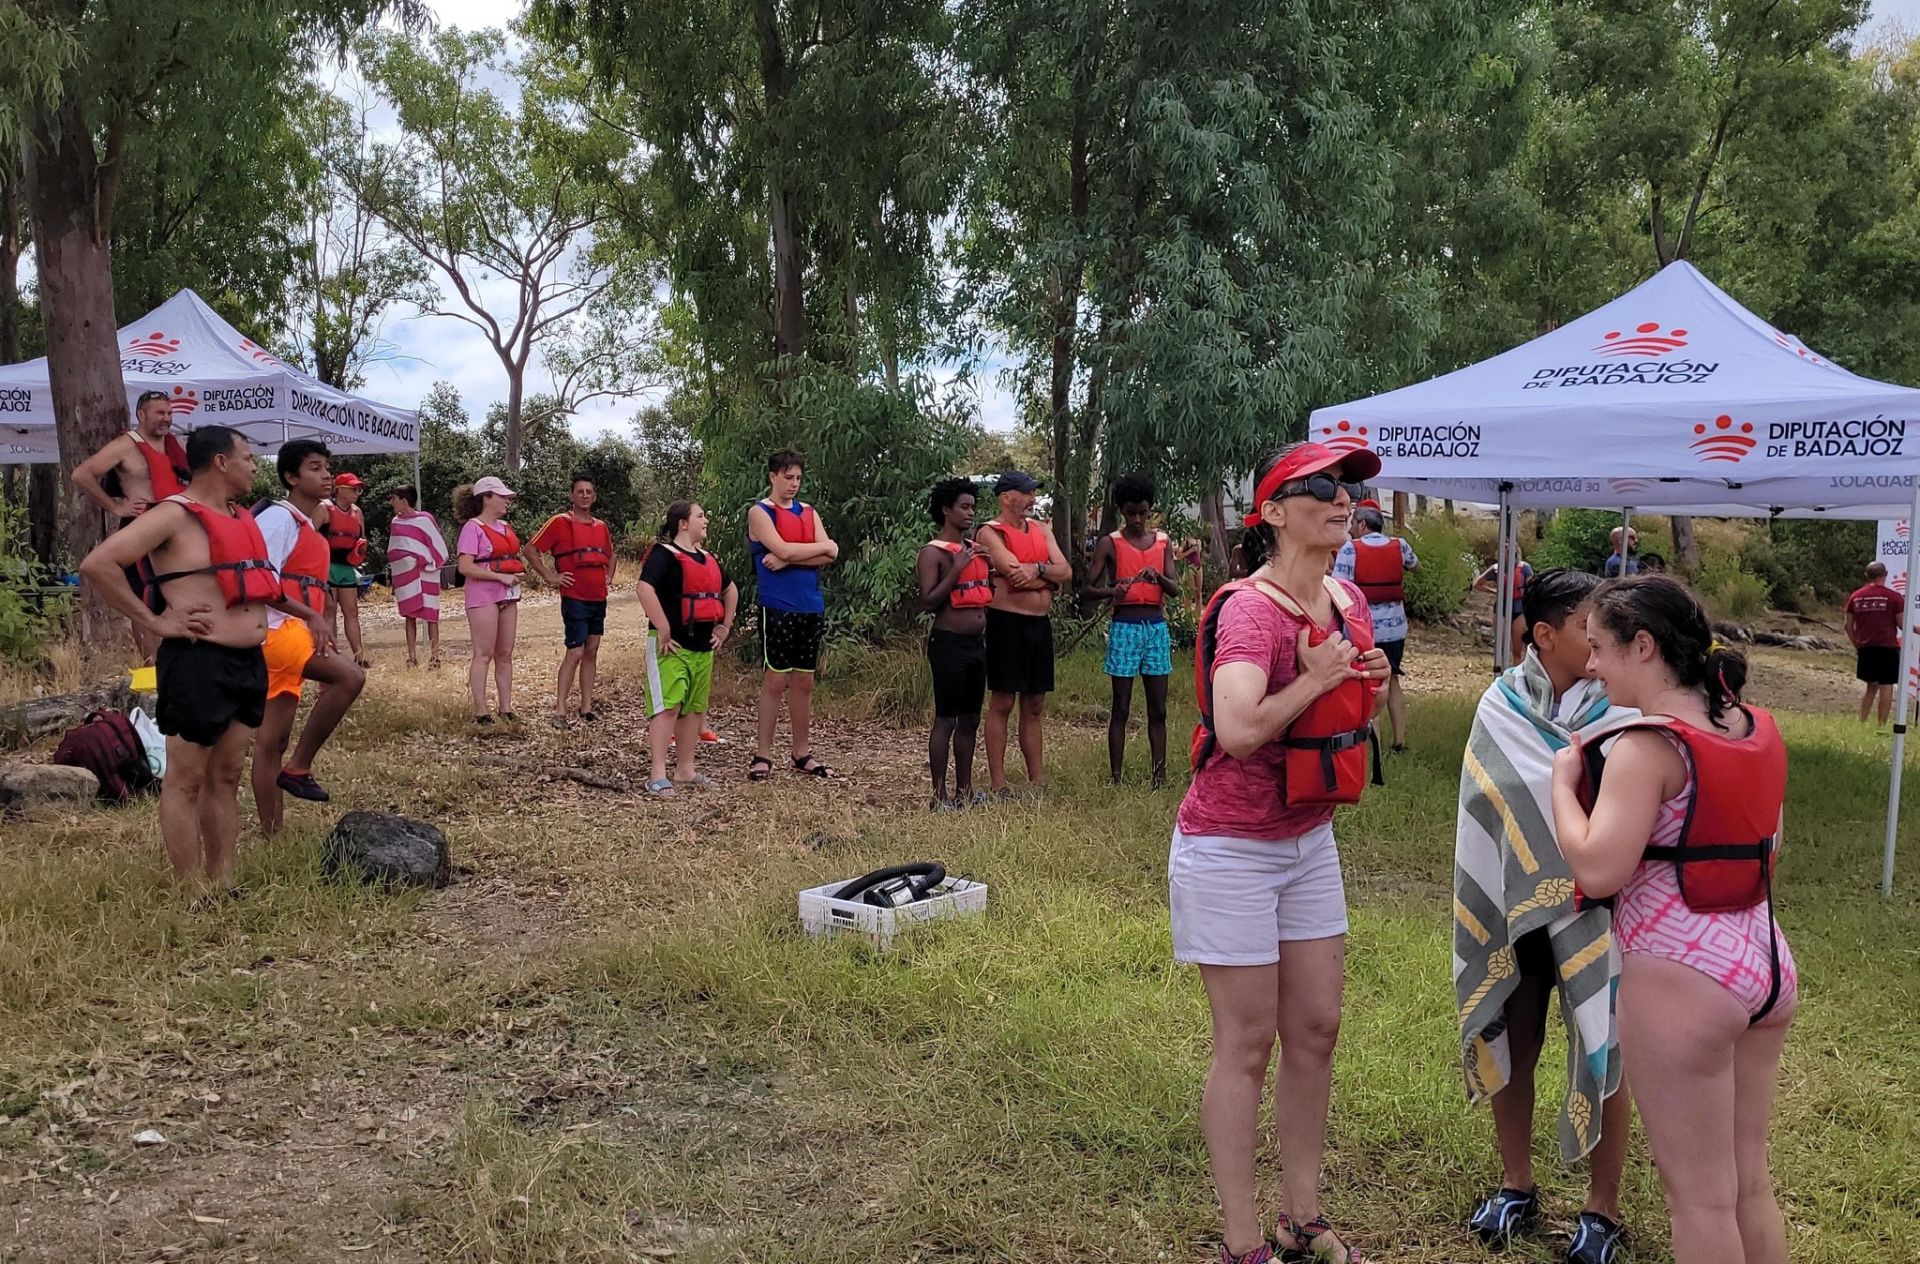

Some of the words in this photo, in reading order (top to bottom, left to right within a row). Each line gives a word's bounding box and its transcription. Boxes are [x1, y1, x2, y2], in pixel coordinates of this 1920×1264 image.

[1532, 359, 1719, 379] DIPUTACIÓN
[1521, 380, 1553, 390] DE
[1559, 373, 1712, 387] BADAJOZ
[203, 384, 275, 401] DIPUTACIÓN
[204, 403, 216, 412] DE
[219, 398, 275, 412] BADAJOZ
[291, 389, 355, 428] DIPUTACIÓN
[358, 411, 369, 432] DE
[371, 415, 414, 442] BADAJOZ
[1379, 421, 1481, 442] DIPUTACIÓN
[1769, 414, 1906, 440] DIPUTACIÓN
[1376, 446, 1392, 457] DE
[1397, 442, 1480, 458] BADAJOZ
[1766, 445, 1788, 458] DE
[1794, 438, 1904, 457] BADAJOZ
